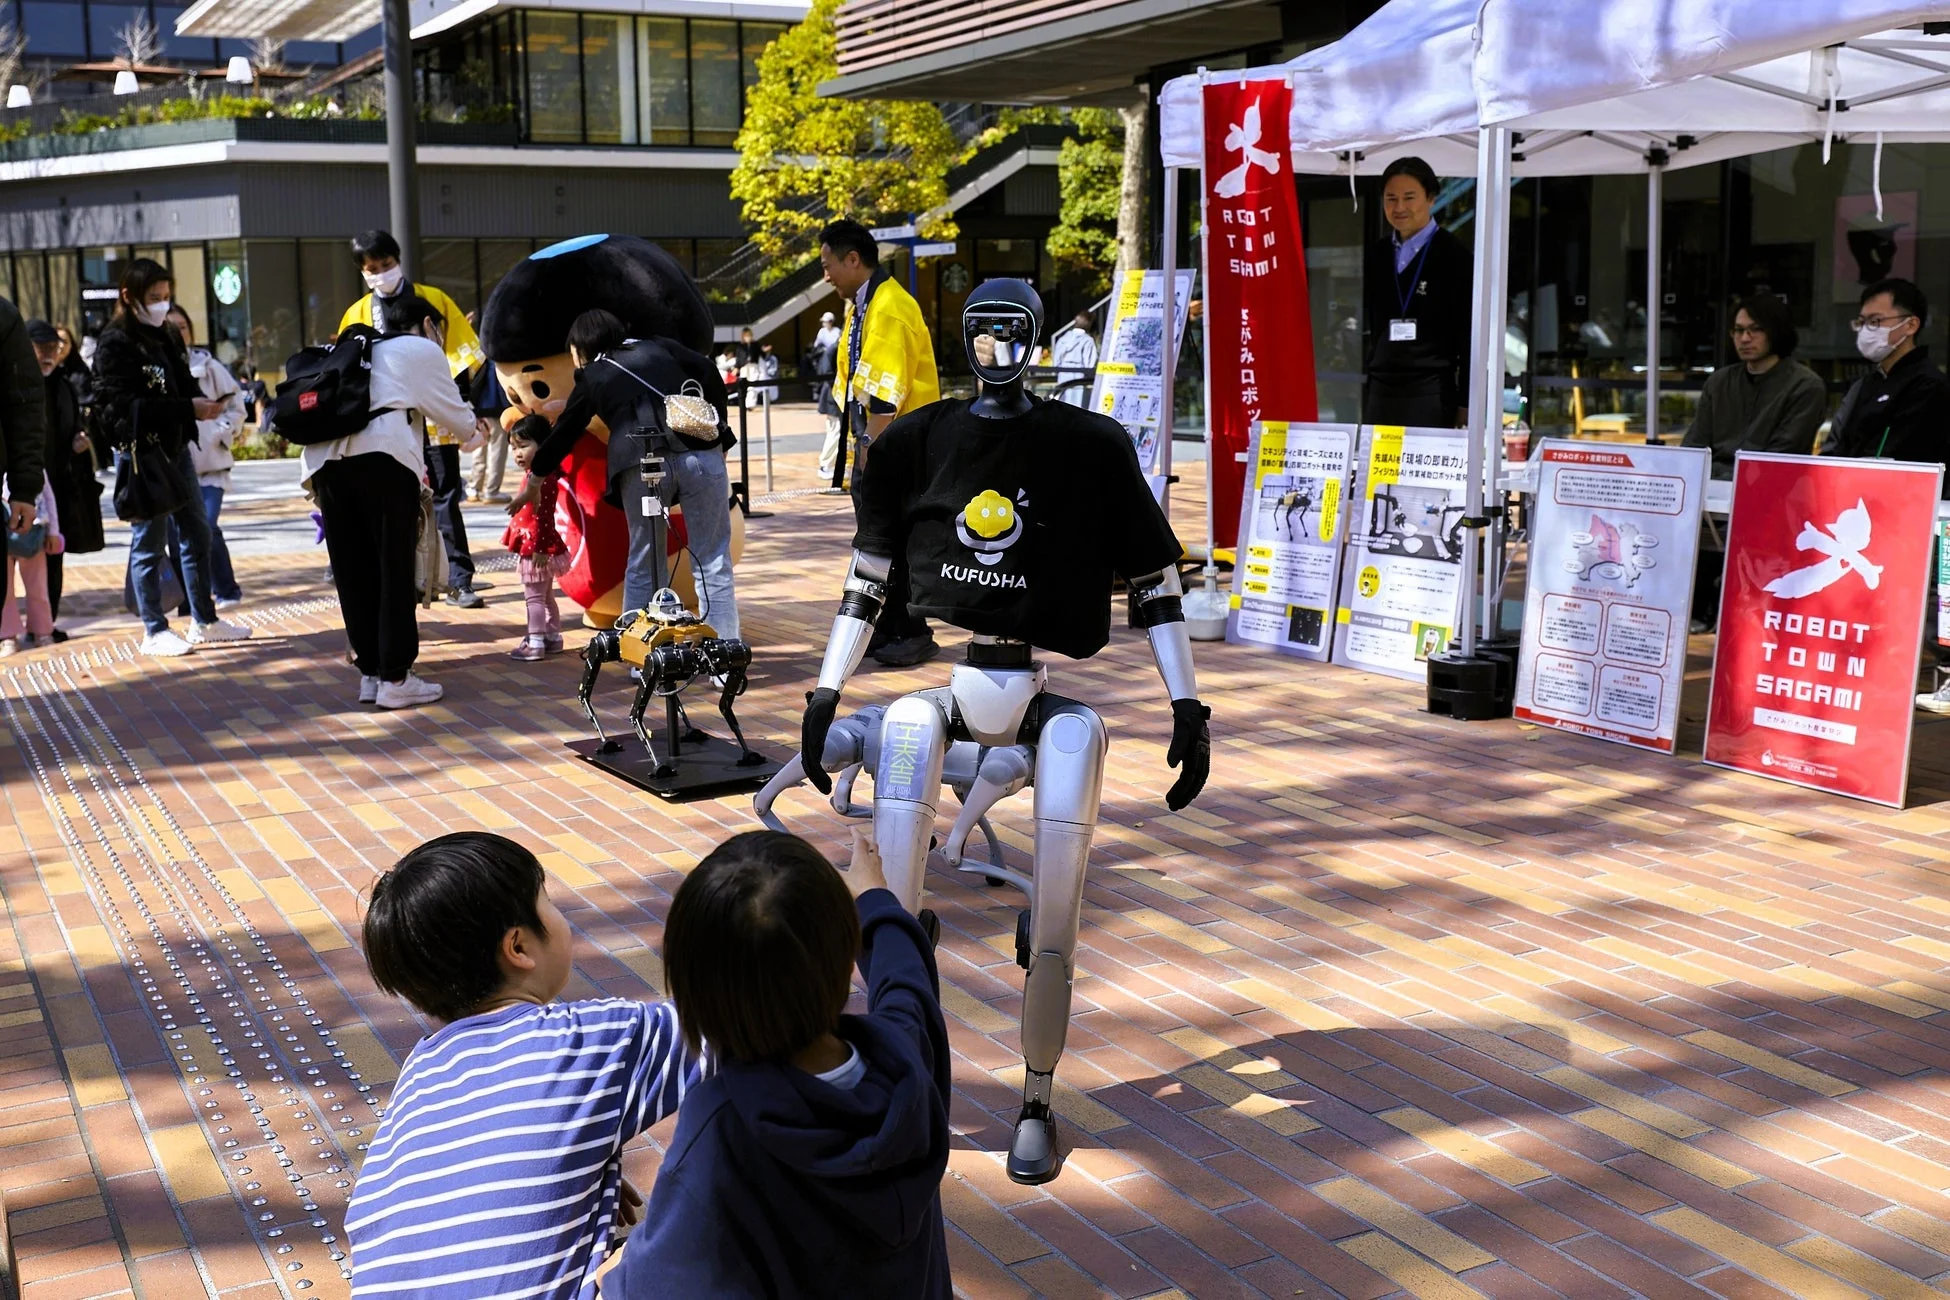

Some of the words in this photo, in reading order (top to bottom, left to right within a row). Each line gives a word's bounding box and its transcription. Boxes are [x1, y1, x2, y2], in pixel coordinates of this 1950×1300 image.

[1552, 452, 1624, 464] さがみロボット産業特区とは
[940, 563, 1029, 590] KUFUSHA
[1763, 610, 1870, 644] ROBOT
[1761, 642, 1866, 678] TOWN
[1755, 673, 1863, 711] SAGAMI
